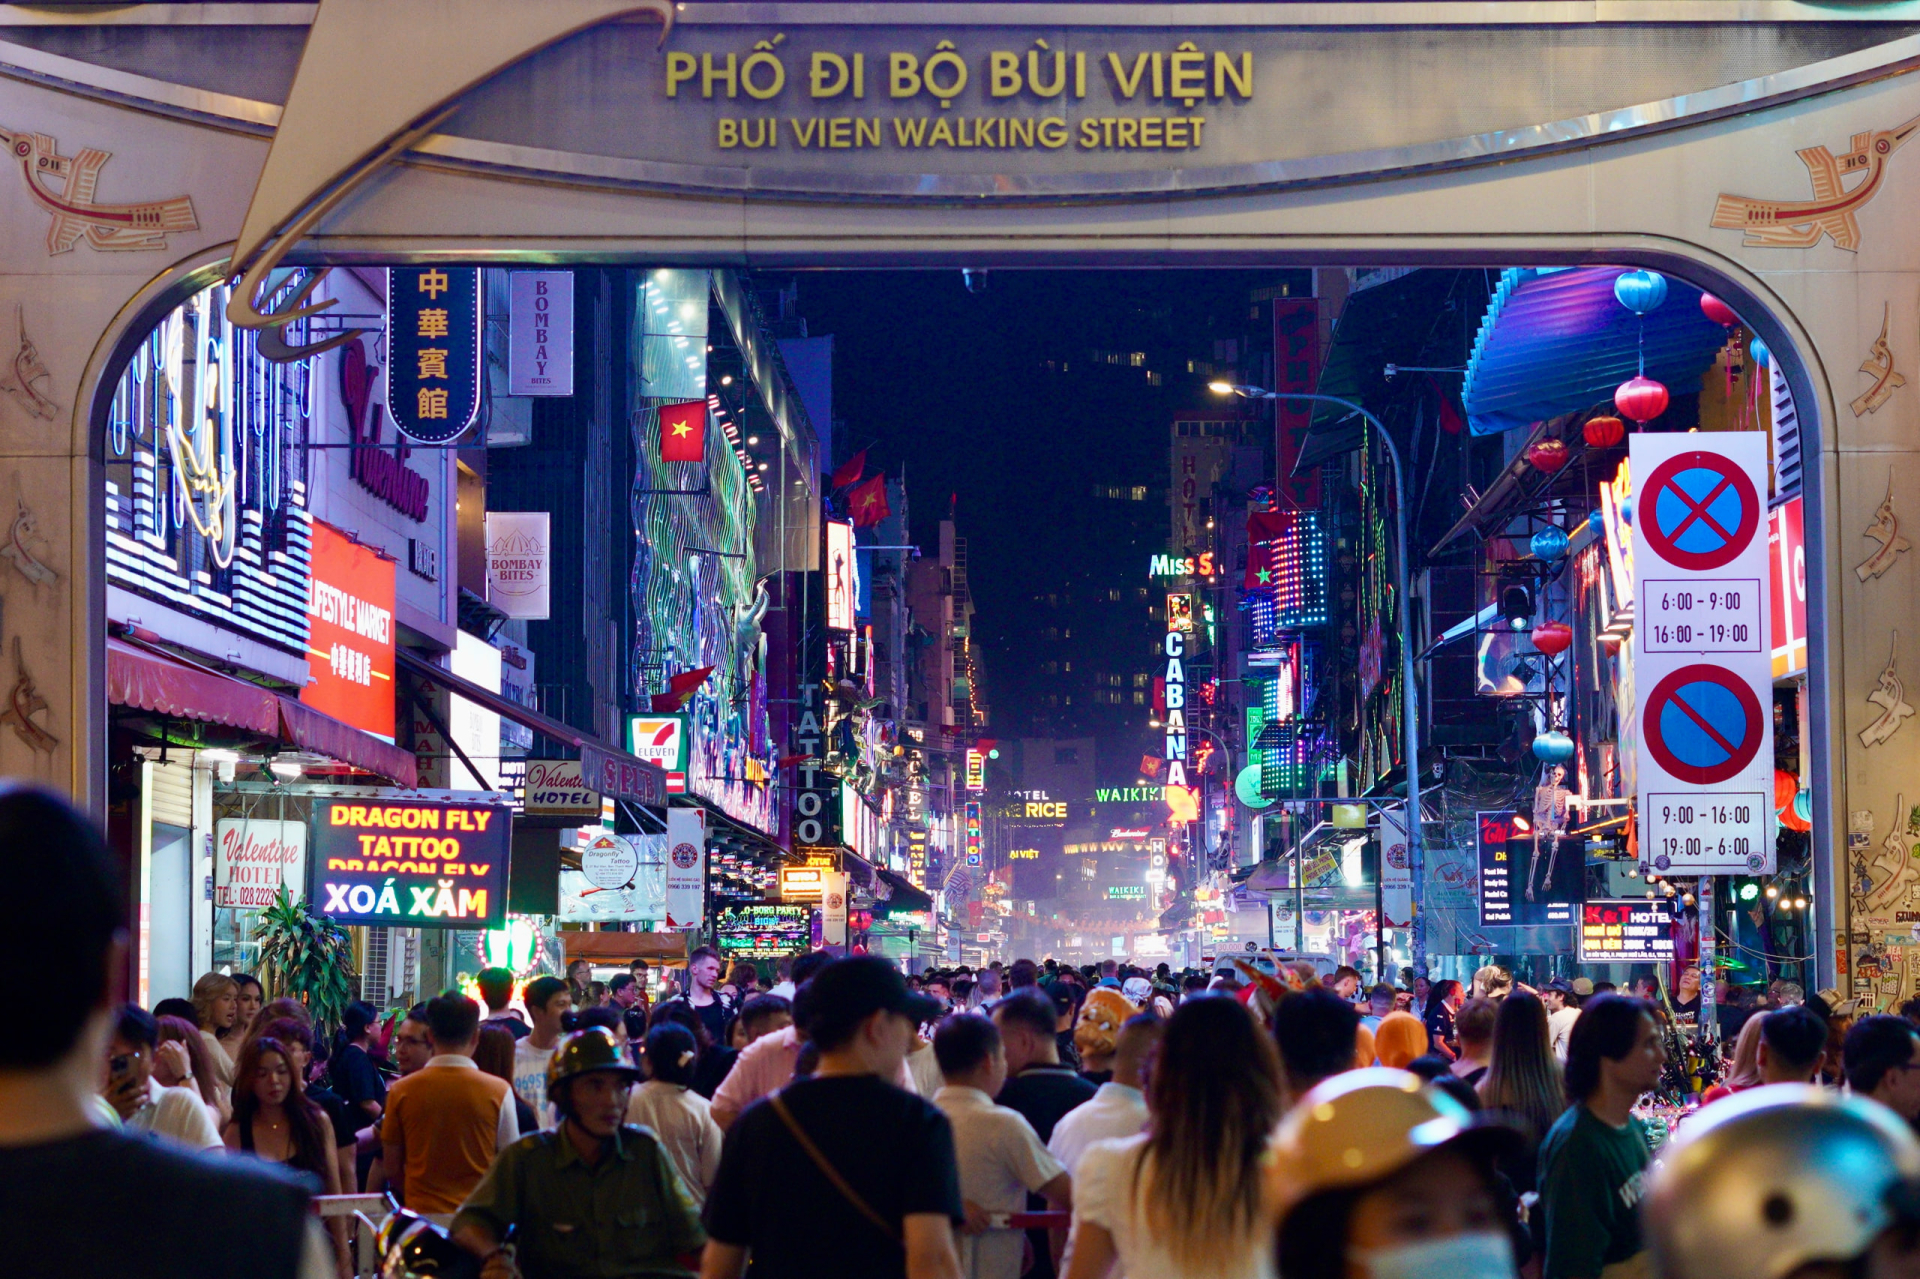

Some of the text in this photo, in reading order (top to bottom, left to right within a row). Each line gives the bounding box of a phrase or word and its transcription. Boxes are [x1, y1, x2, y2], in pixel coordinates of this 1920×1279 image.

[665, 33, 1253, 108] PHỐ ĐI BỘ BÙI VIỆN
[719, 116, 1205, 149] BUI VIEN WALKING STREET
[535, 280, 549, 376] BOMBAY
[417, 268, 448, 420] 中華賓館
[492, 559, 542, 570] BOMBAY
[500, 570, 534, 580] BITES
[309, 577, 391, 645] LIFESTYLE MARKET
[1662, 592, 1692, 611] 6:00
[1710, 592, 1740, 611] 9:00
[1654, 624, 1692, 643] 16:00
[1710, 624, 1747, 642] 19:00
[1165, 632, 1187, 785] CABANA
[798, 684, 822, 843] TATTOO
[533, 791, 591, 804] HOTEL
[1096, 786, 1166, 802] WAIKIKI
[331, 805, 491, 831] DRAGON FLY
[1026, 802, 1067, 818] RICE
[1663, 806, 1693, 824] 9:00
[1712, 806, 1750, 824] 16:00
[223, 828, 298, 864] Valentine
[359, 835, 460, 860] TATTOO
[1662, 838, 1701, 856] 19:00
[1719, 837, 1749, 856] 6:00
[1152, 841, 1164, 908] HOEL
[217, 886, 237, 904] TEL:
[240, 886, 254, 905] 028
[256, 887, 274, 906] 2223
[324, 878, 487, 918] XOÁ XĂM
[1108, 886, 1144, 894] WAIKIKI
[776, 905, 803, 916] PARTY
[1631, 912, 1671, 923] HOTEL
